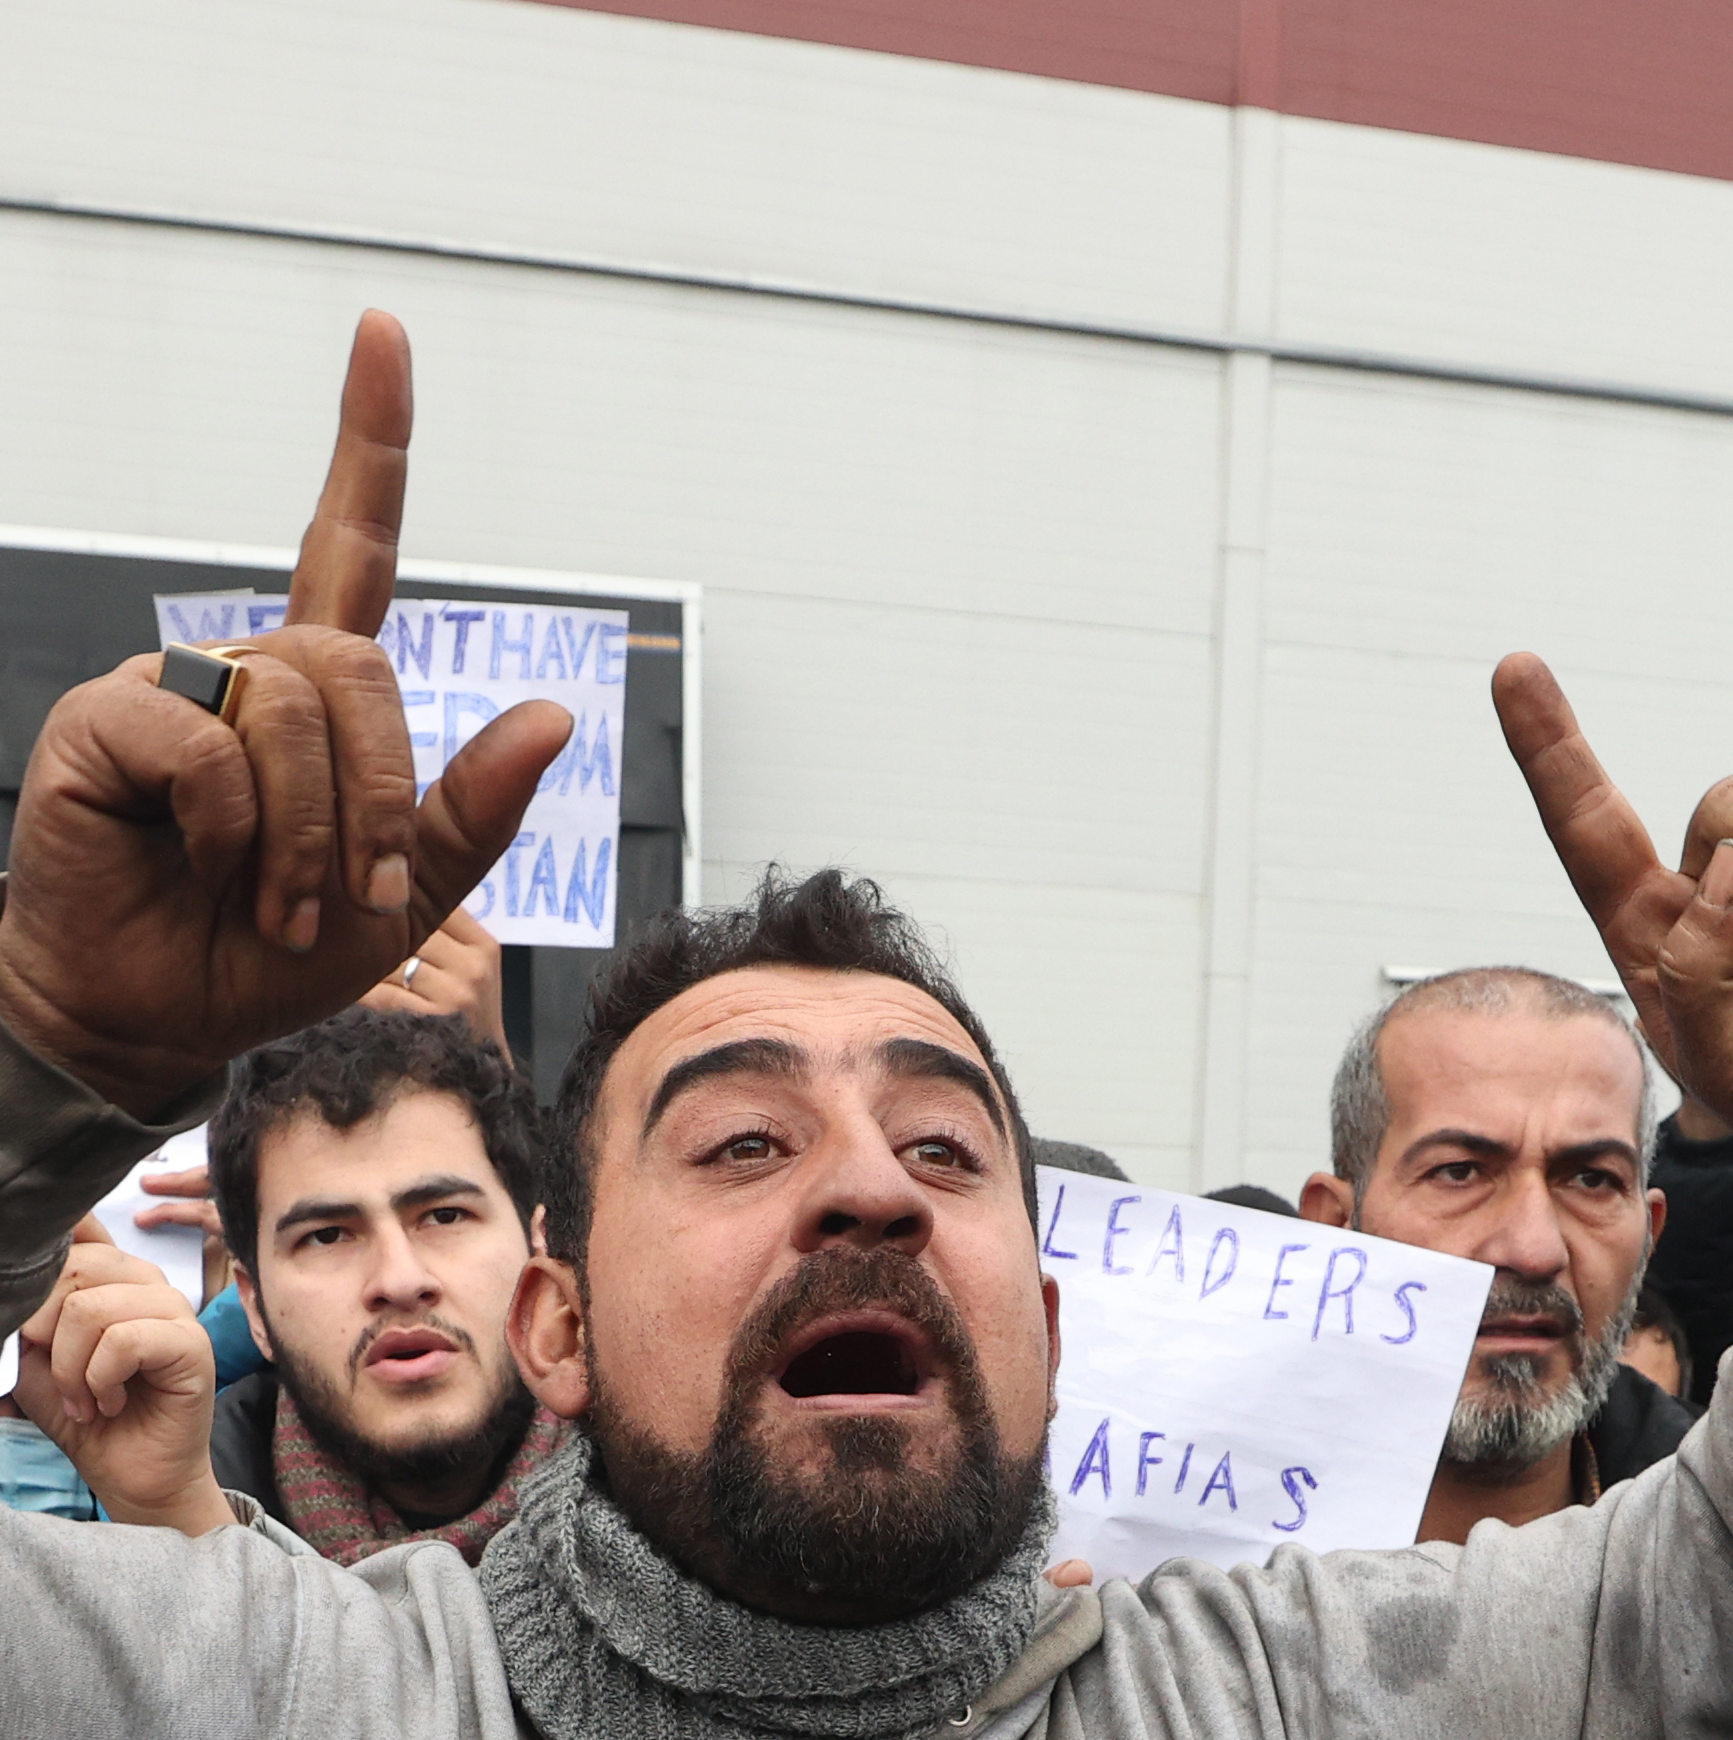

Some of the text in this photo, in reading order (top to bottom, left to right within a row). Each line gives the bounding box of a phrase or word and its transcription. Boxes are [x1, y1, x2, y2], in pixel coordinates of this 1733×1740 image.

[489, 610, 626, 685] HAVE
[1041, 1183, 1429, 1345] LEADERS
[1044, 1417, 1317, 1532] AFIAS
